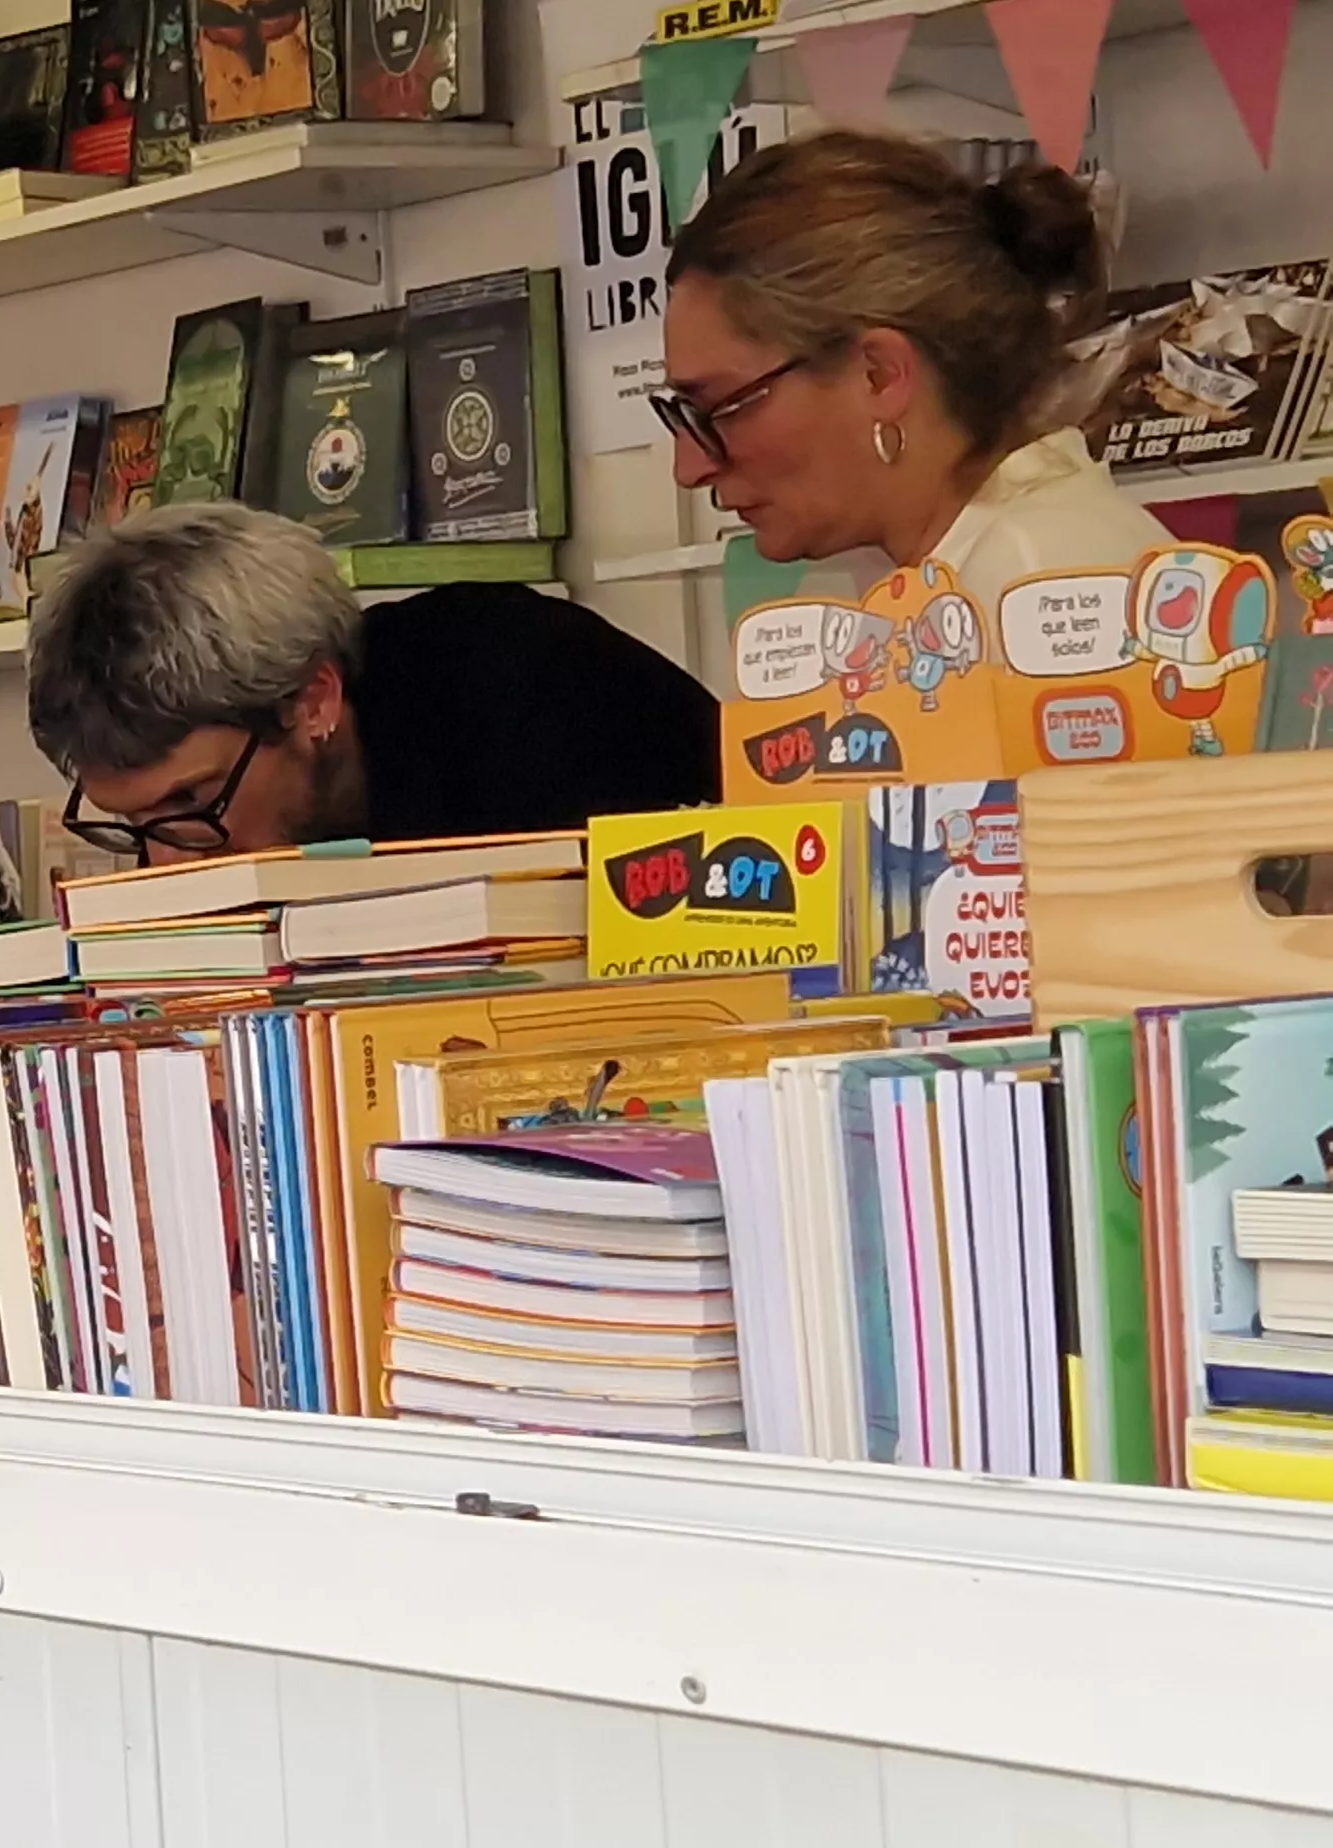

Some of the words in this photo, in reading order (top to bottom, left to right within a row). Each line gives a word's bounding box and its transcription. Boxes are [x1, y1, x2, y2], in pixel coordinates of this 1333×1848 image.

[575, 99, 610, 144] EL
[587, 276, 662, 332] LIBR
[801, 838, 817, 862] 6
[956, 880, 1026, 924] ¿QUIÉ
